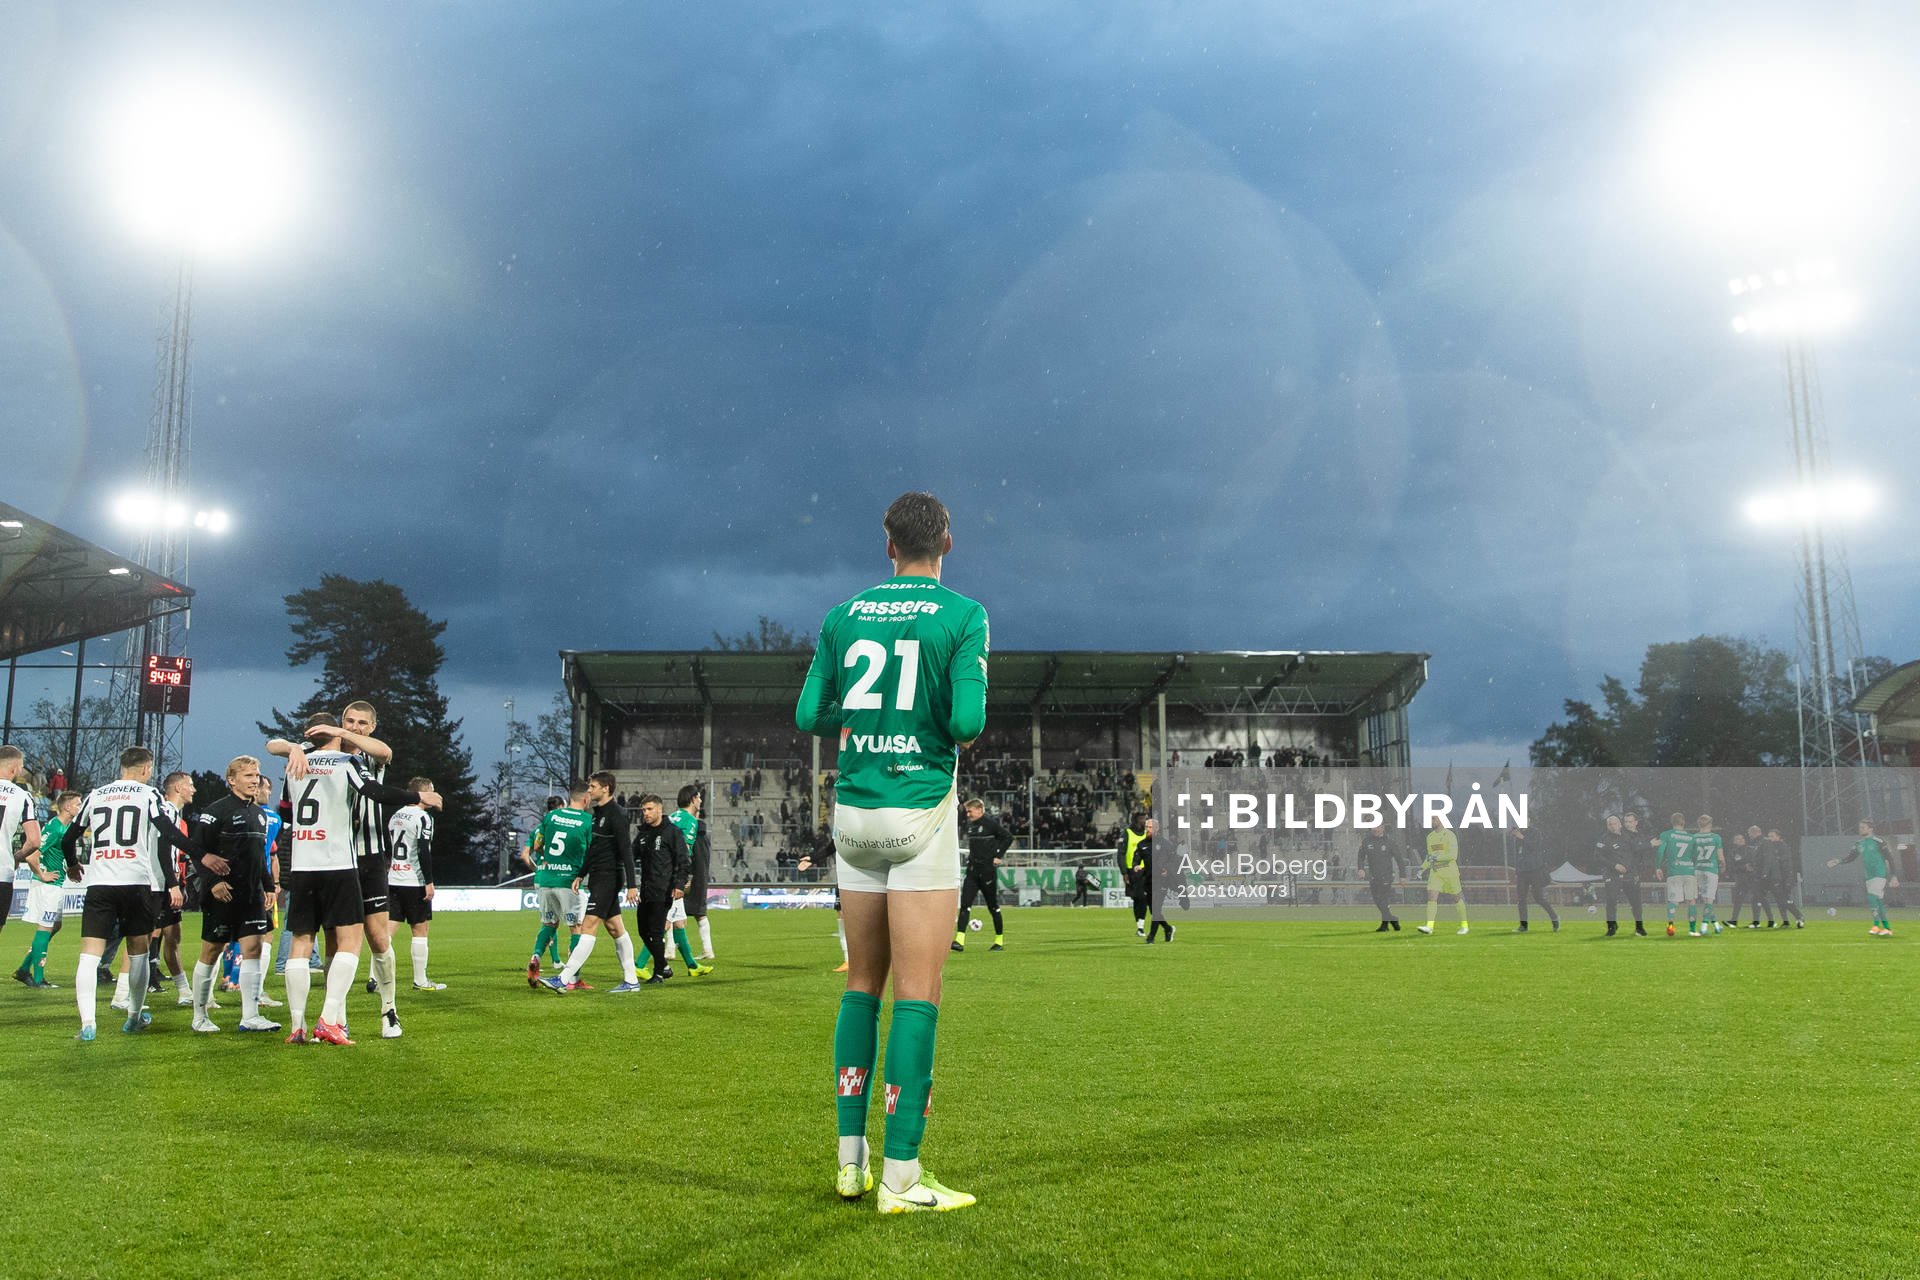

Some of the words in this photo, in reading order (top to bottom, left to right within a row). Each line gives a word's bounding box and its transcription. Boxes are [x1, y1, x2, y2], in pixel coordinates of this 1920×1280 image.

[149, 655, 158, 668] 2
[176, 658, 184, 670] 4
[150, 670, 181, 685] 94:48
[842, 639, 920, 711] 21
[852, 734, 922, 754] YUASA
[97, 785, 143, 796] SERNEKE
[296, 778, 320, 826] 6
[93, 805, 141, 849] 20
[548, 831, 567, 857] 5
[1675, 842, 1689, 858] 7
[95, 849, 137, 861] PULS
[1697, 845, 1716, 861] 27
[547, 863, 573, 872] YUASA
